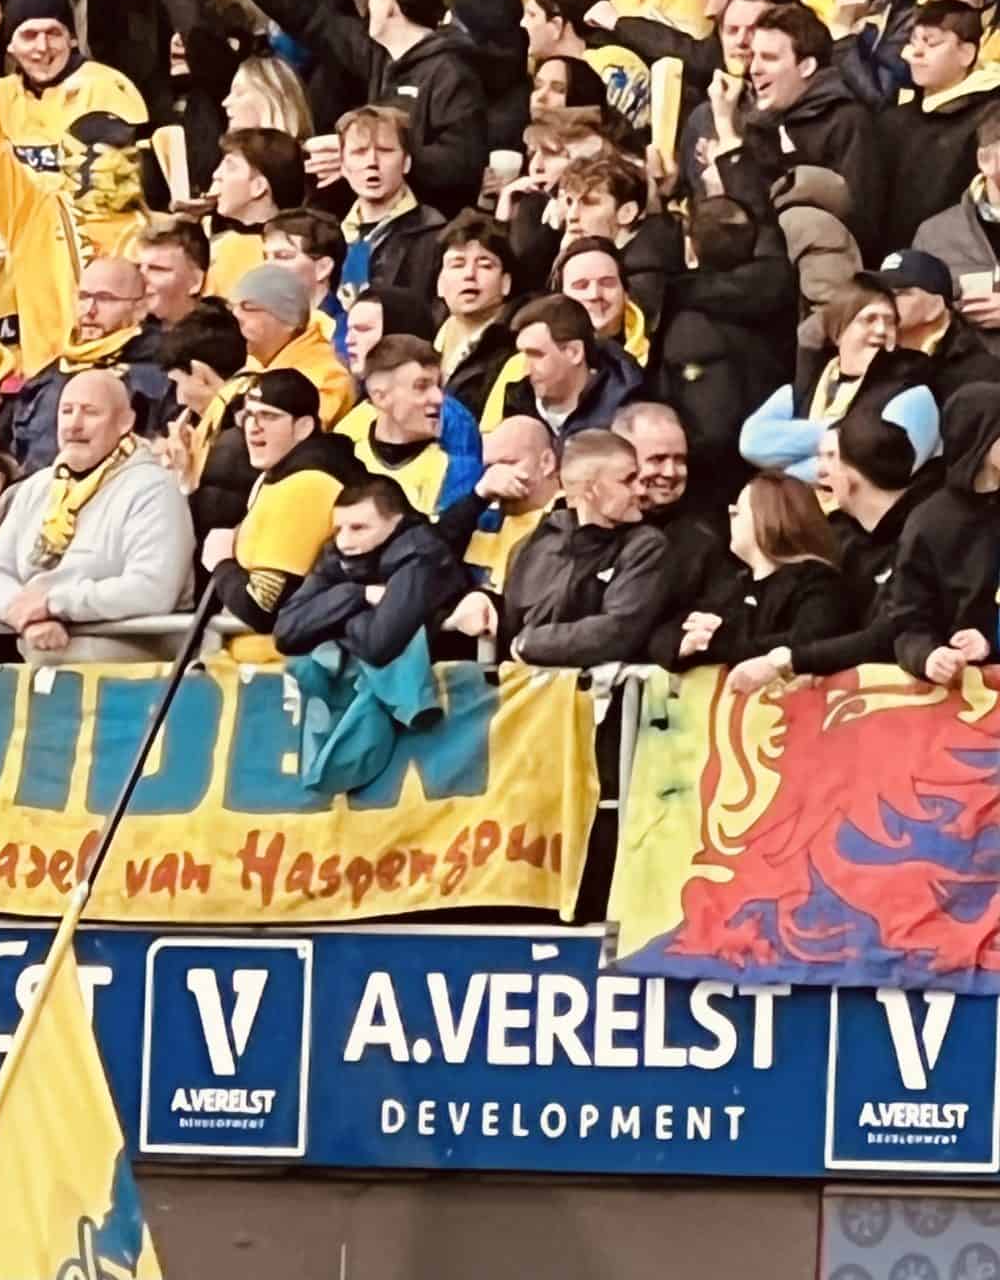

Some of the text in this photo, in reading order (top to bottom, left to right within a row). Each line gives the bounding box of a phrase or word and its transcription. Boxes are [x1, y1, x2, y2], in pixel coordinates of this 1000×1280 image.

[125, 850, 211, 897] van
[343, 972, 792, 1069] A.VERELST
[381, 1099, 745, 1141] DEVELOPMENT
